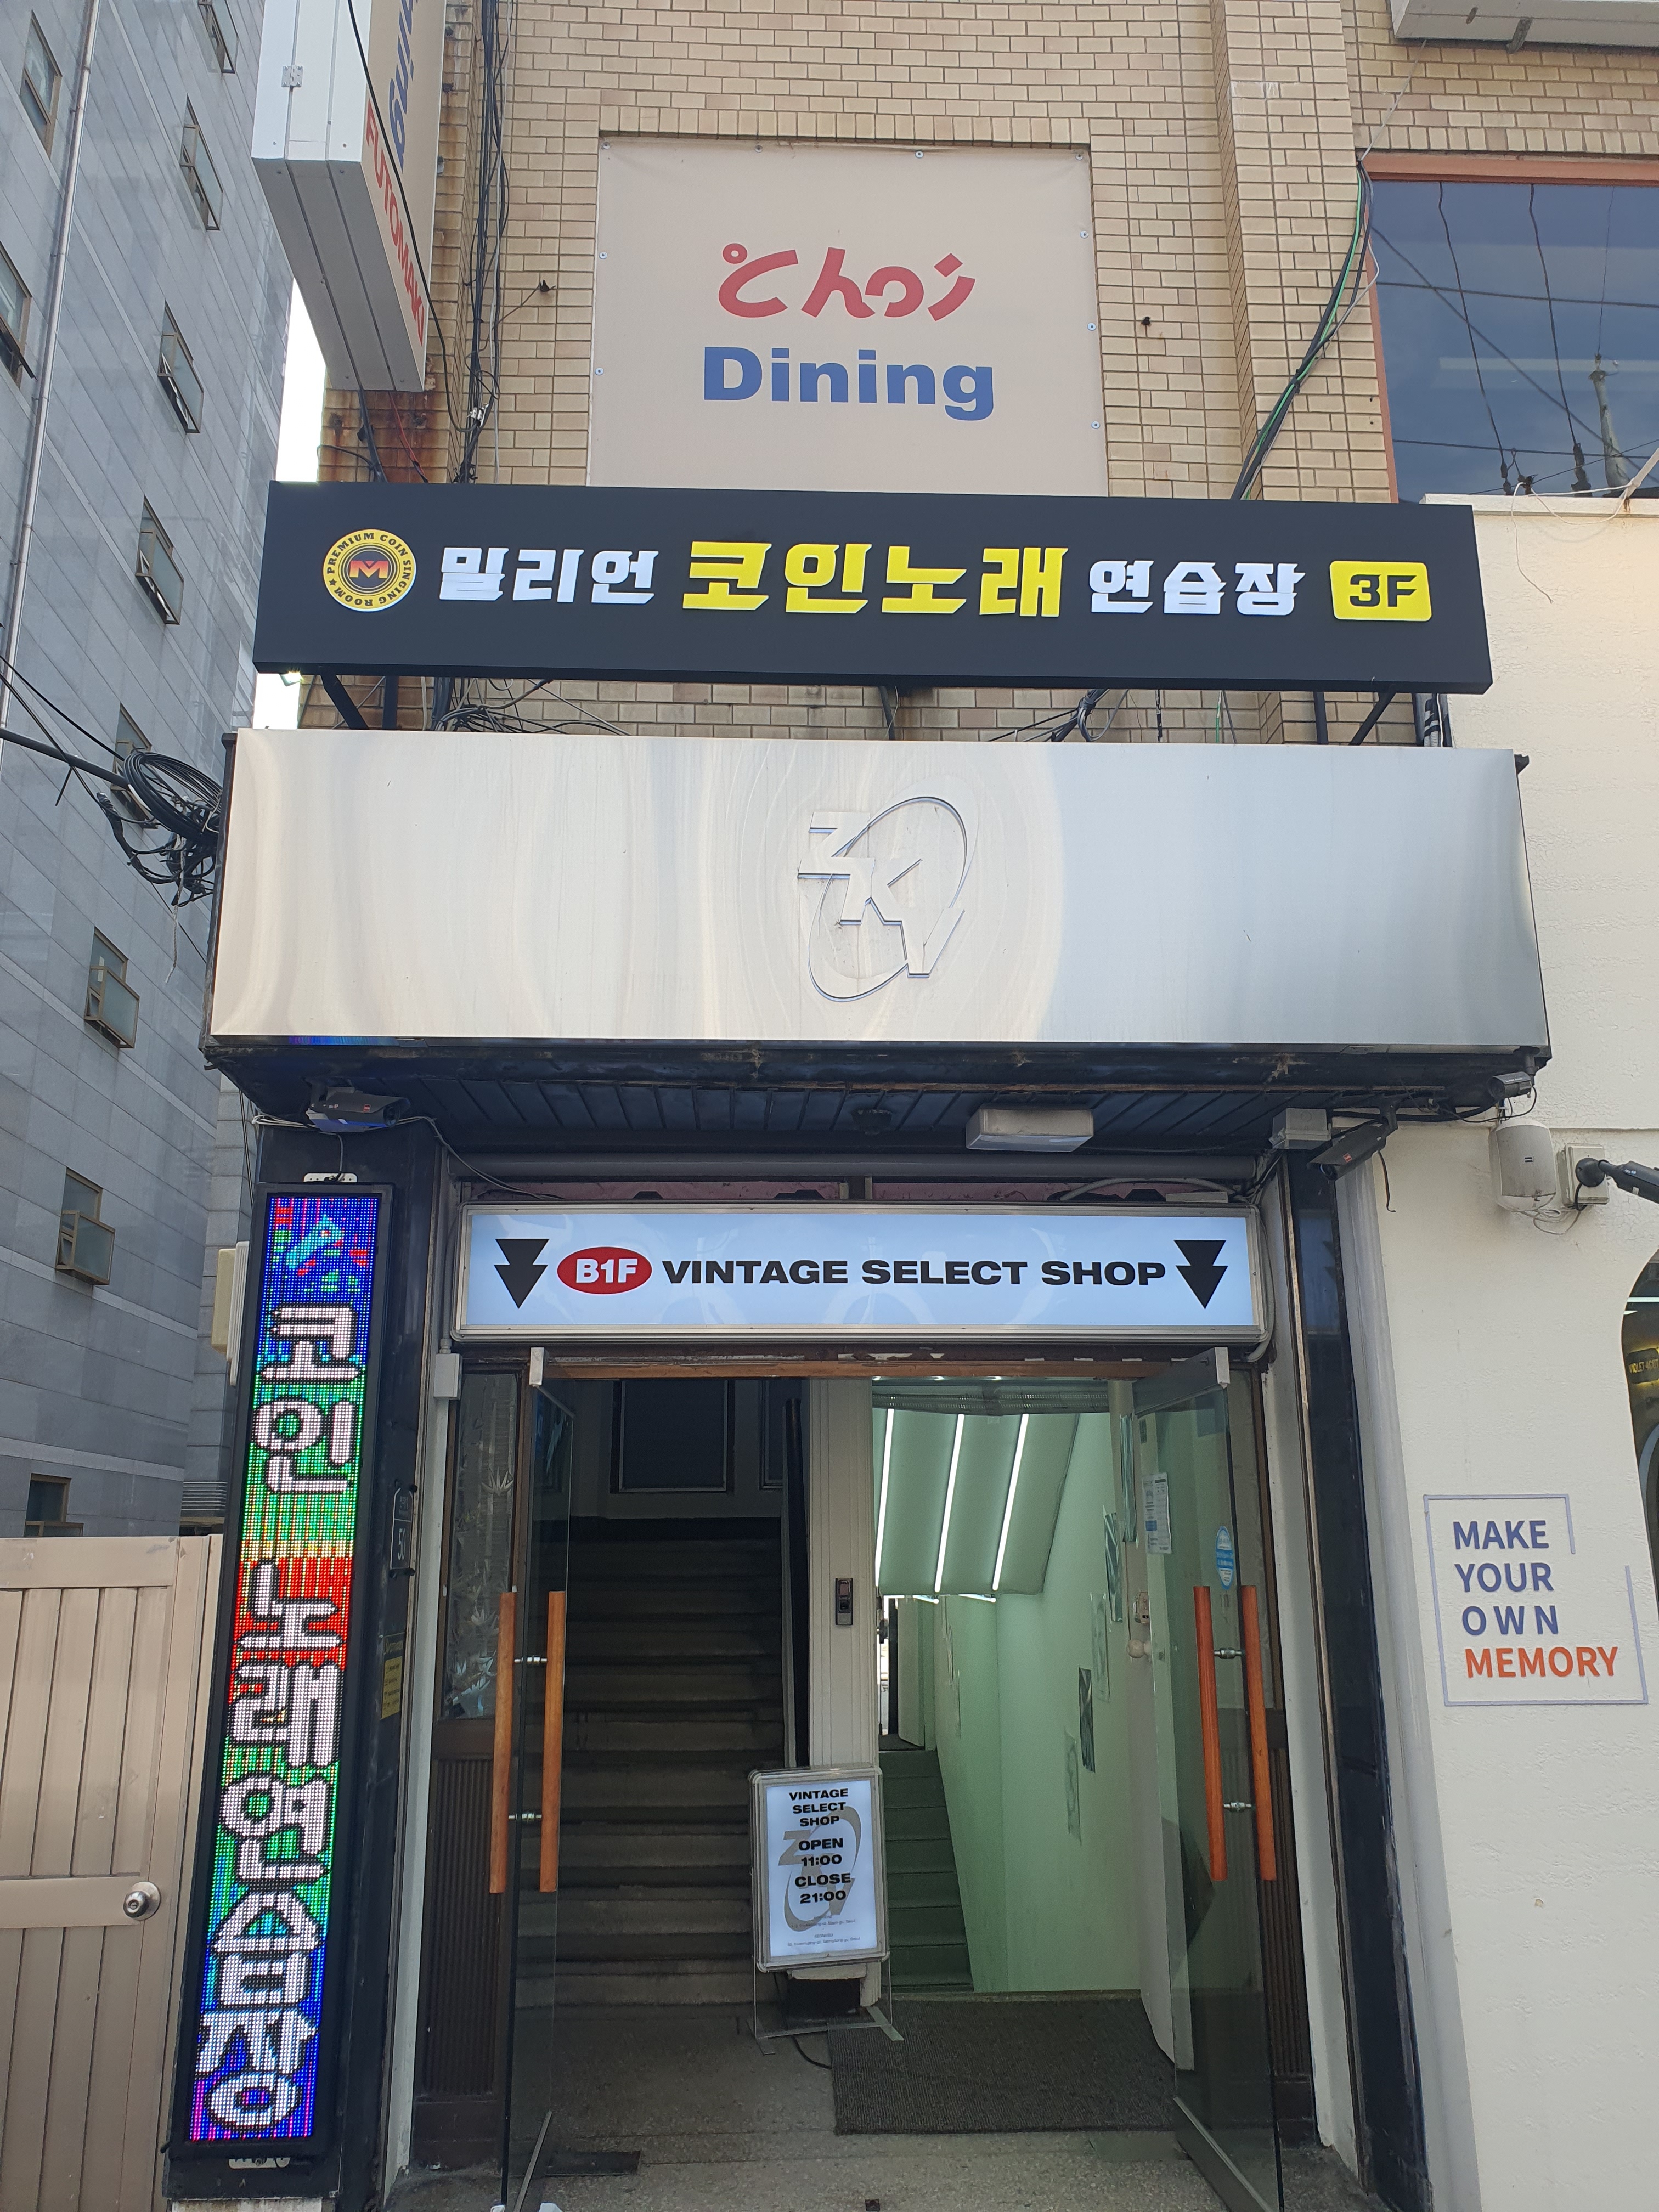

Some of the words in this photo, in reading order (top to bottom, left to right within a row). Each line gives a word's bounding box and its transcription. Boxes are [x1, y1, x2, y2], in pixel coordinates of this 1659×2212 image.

[365, 99, 425, 347] FUTOMAKI
[704, 346, 994, 421] Dining
[326, 532, 375, 574] PREMIUM
[380, 534, 408, 557] COIN
[378, 559, 411, 604] SINGING
[439, 546, 659, 605] 밀리언
[1088, 560, 1306, 616] 연습장
[1349, 573, 1418, 607] 3F
[334, 586, 373, 606] ROOM
[575, 1258, 639, 1283] B1F
[662, 1260, 849, 1284] VINTAGE
[861, 1259, 1028, 1285] SELECT
[1041, 1260, 1166, 1286] SHOP
[398, 1528, 406, 1561] 50
[1452, 1519, 1550, 1550] MAKE
[1455, 1562, 1554, 1593] YOUR
[1462, 1604, 1559, 1636] OWN
[1465, 1646, 1619, 1678] MEMORY
[788, 1788, 849, 1801] VINTAGE
[792, 1802, 847, 1814] SELECT
[799, 1815, 840, 1827] SHOP
[798, 1837, 844, 1852] OPEN
[800, 1854, 843, 1867] 11:00
[794, 1872, 851, 1888] CLOSE
[799, 1889, 847, 1904] 21:00
